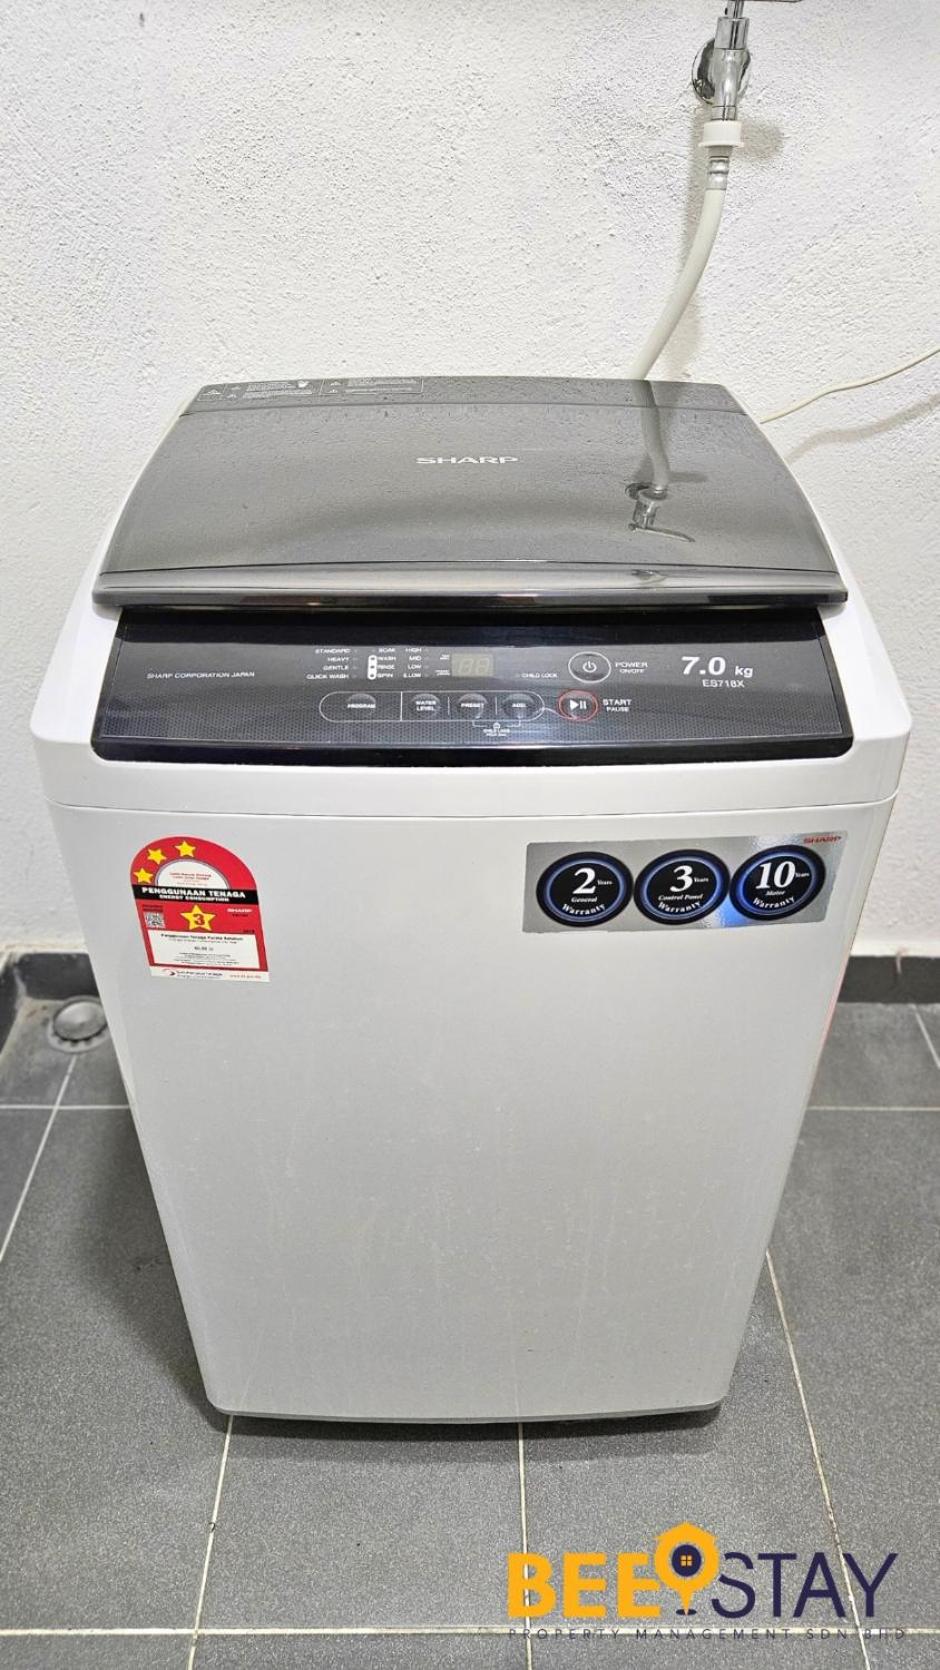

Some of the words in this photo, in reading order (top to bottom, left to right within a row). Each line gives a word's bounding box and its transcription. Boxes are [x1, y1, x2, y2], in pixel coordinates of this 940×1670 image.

[416, 456, 519, 465] SHARP
[681, 656, 726, 676] 7.0
[734, 665, 753, 678] kg
[803, 836, 842, 844] SHARP
[572, 867, 596, 894] 2
[670, 865, 693, 892] 3
[755, 860, 796, 889] 10
[141, 887, 206, 897] PENGGUNAAN
[208, 890, 246, 899] TENAGA
[658, 901, 700, 913] Warranty
[752, 896, 795, 908] Warranty
[562, 903, 606, 915] Warranty
[192, 913, 206, 926] 3
